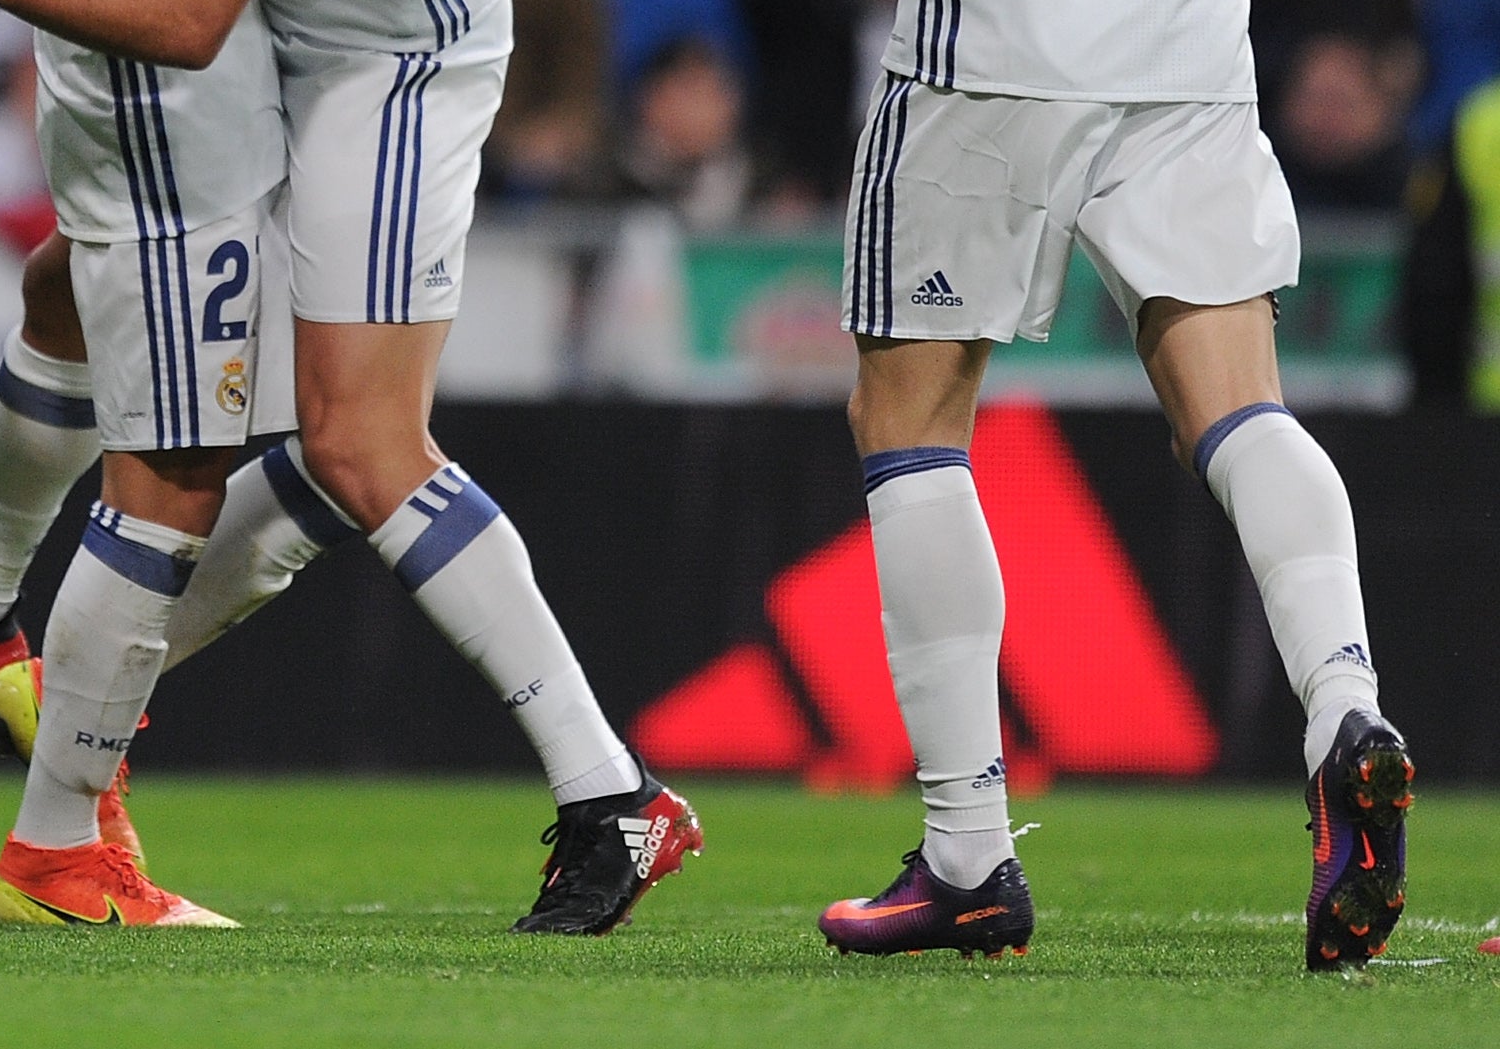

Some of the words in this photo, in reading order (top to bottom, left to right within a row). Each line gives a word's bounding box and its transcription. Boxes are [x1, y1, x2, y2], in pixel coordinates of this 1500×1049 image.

[202, 239, 259, 343] 2
[911, 293, 963, 307] adidas
[636, 815, 670, 879] adidas
